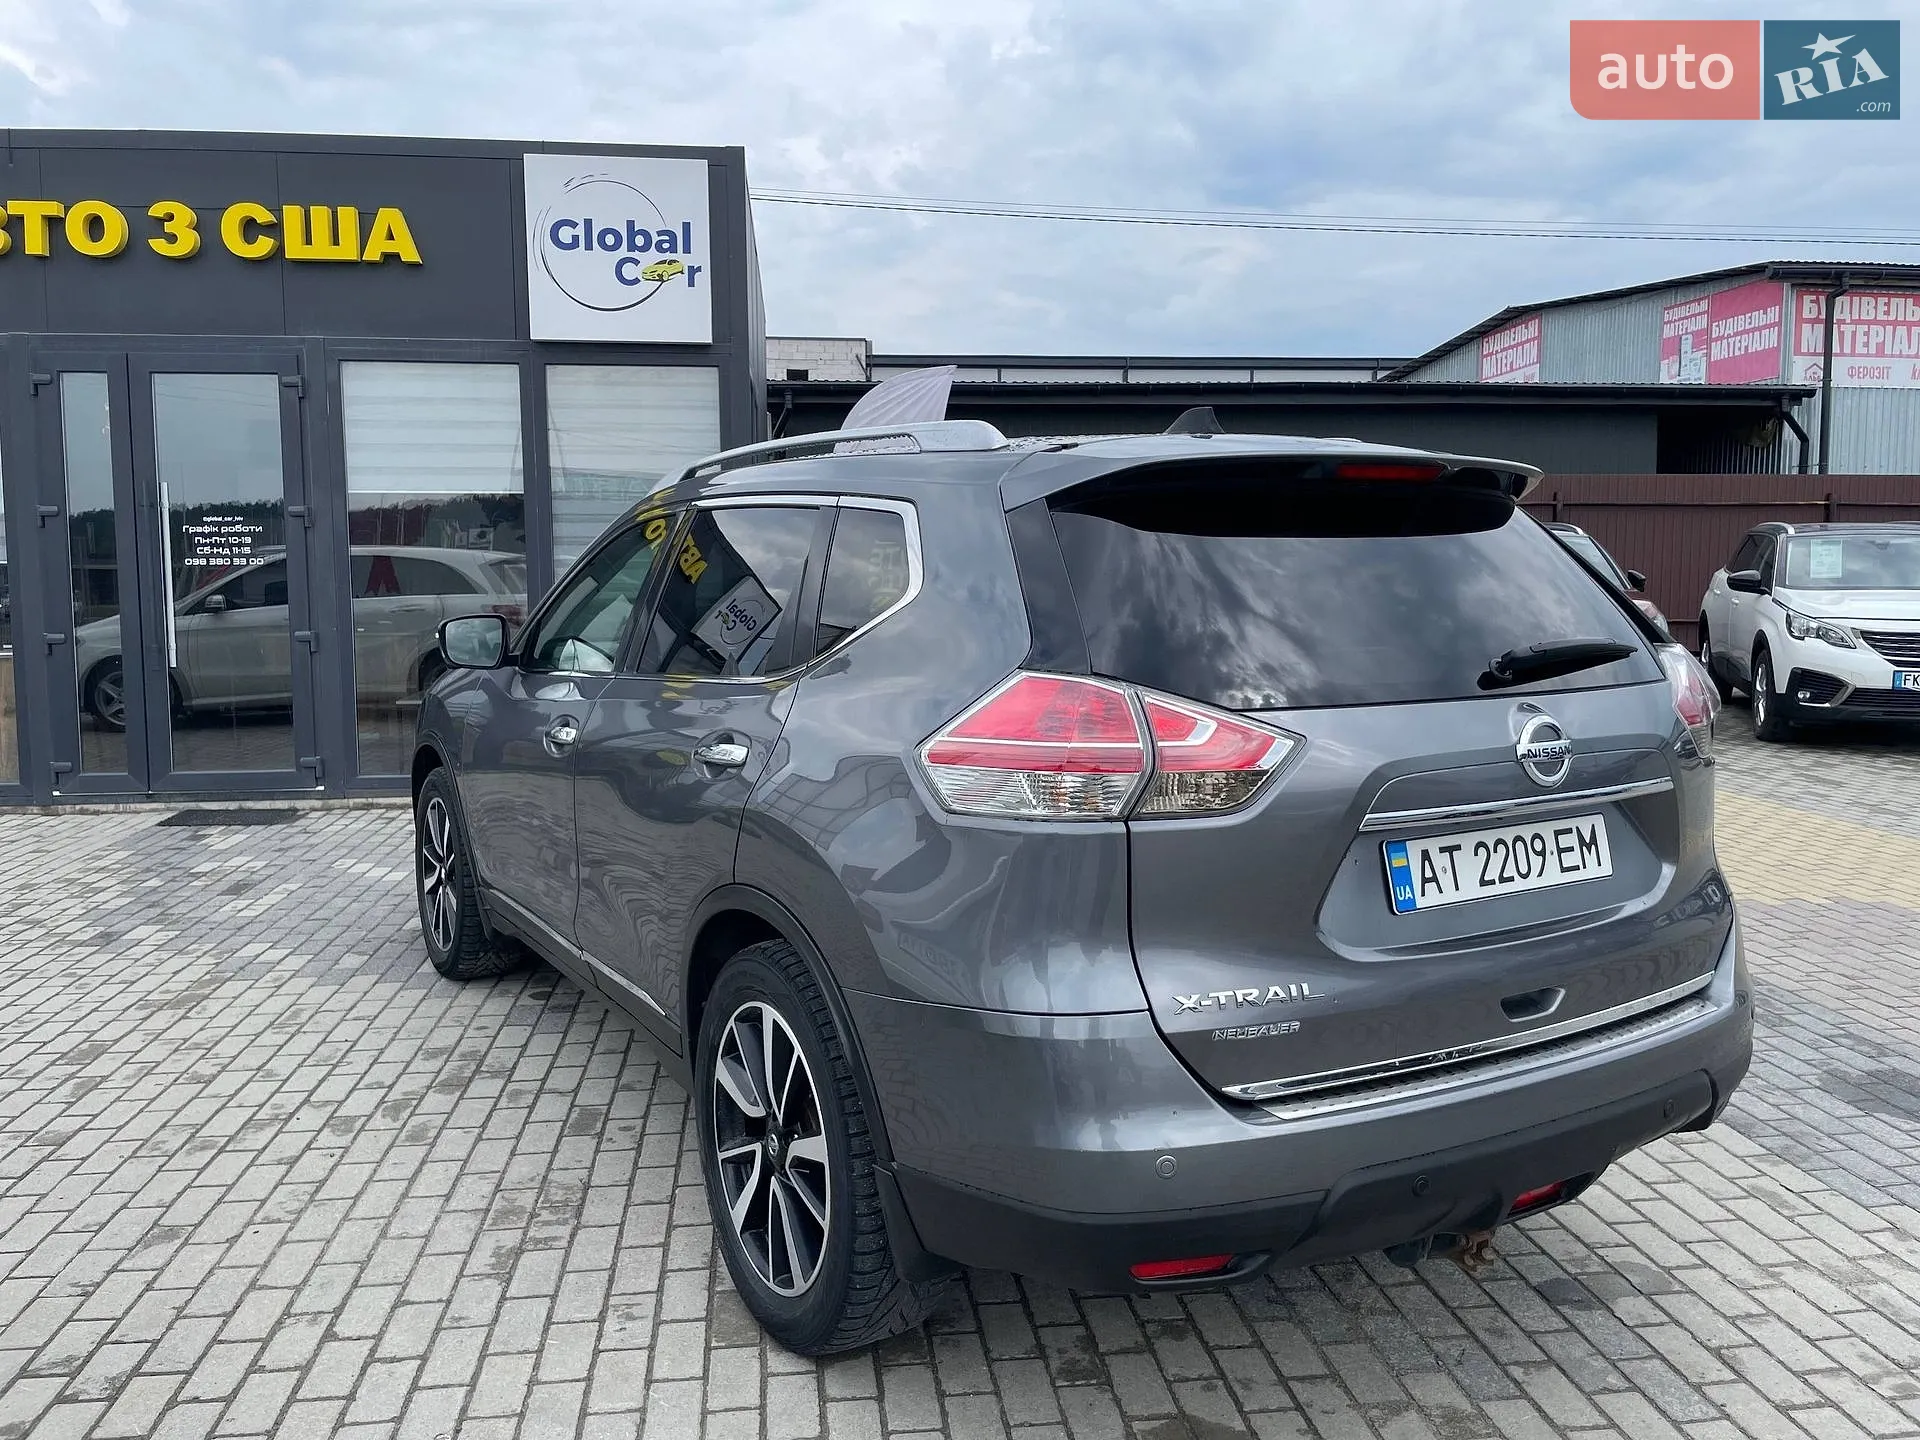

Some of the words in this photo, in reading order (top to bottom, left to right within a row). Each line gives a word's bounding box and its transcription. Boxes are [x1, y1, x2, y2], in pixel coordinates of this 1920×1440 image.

[220, 202, 423, 265] США
[549, 218, 692, 254] Global
[614, 256, 703, 288] Cr
[1664, 299, 1708, 322] БУДІВЕЛЬНІ
[1711, 305, 1780, 338] БУДІВЕЛЬНІ
[1483, 319, 1539, 354] БУДІВЕЛЬНІ
[1663, 314, 1708, 338] МАТЕРІАЛИ
[1710, 326, 1779, 362] МАТЕРІАЛИ
[1482, 340, 1538, 379] МАТЕРІАЛИ
[1847, 365, 1892, 380] ФЕРОЗІТ
[182, 524, 219, 534] Графік
[220, 524, 263, 533] роботи
[194, 536, 226, 544] Пн-Пт
[228, 536, 252, 544] 10-19
[184, 557, 207, 566] 098
[209, 557, 231, 566] 380
[232, 557, 247, 566] 33
[249, 557, 264, 566] 00
[196, 546, 231, 555] Сб-Нд
[232, 546, 252, 554] 11-15
[1527, 744, 1572, 760] NISSAN
[1420, 844, 1461, 897] AT
[1473, 832, 1547, 888] 2209
[1553, 823, 1602, 873] EM
[1396, 884, 1413, 901] UA
[1172, 982, 1325, 1015] X-TRAIL
[1212, 1020, 1301, 1041] NEUBAUER
